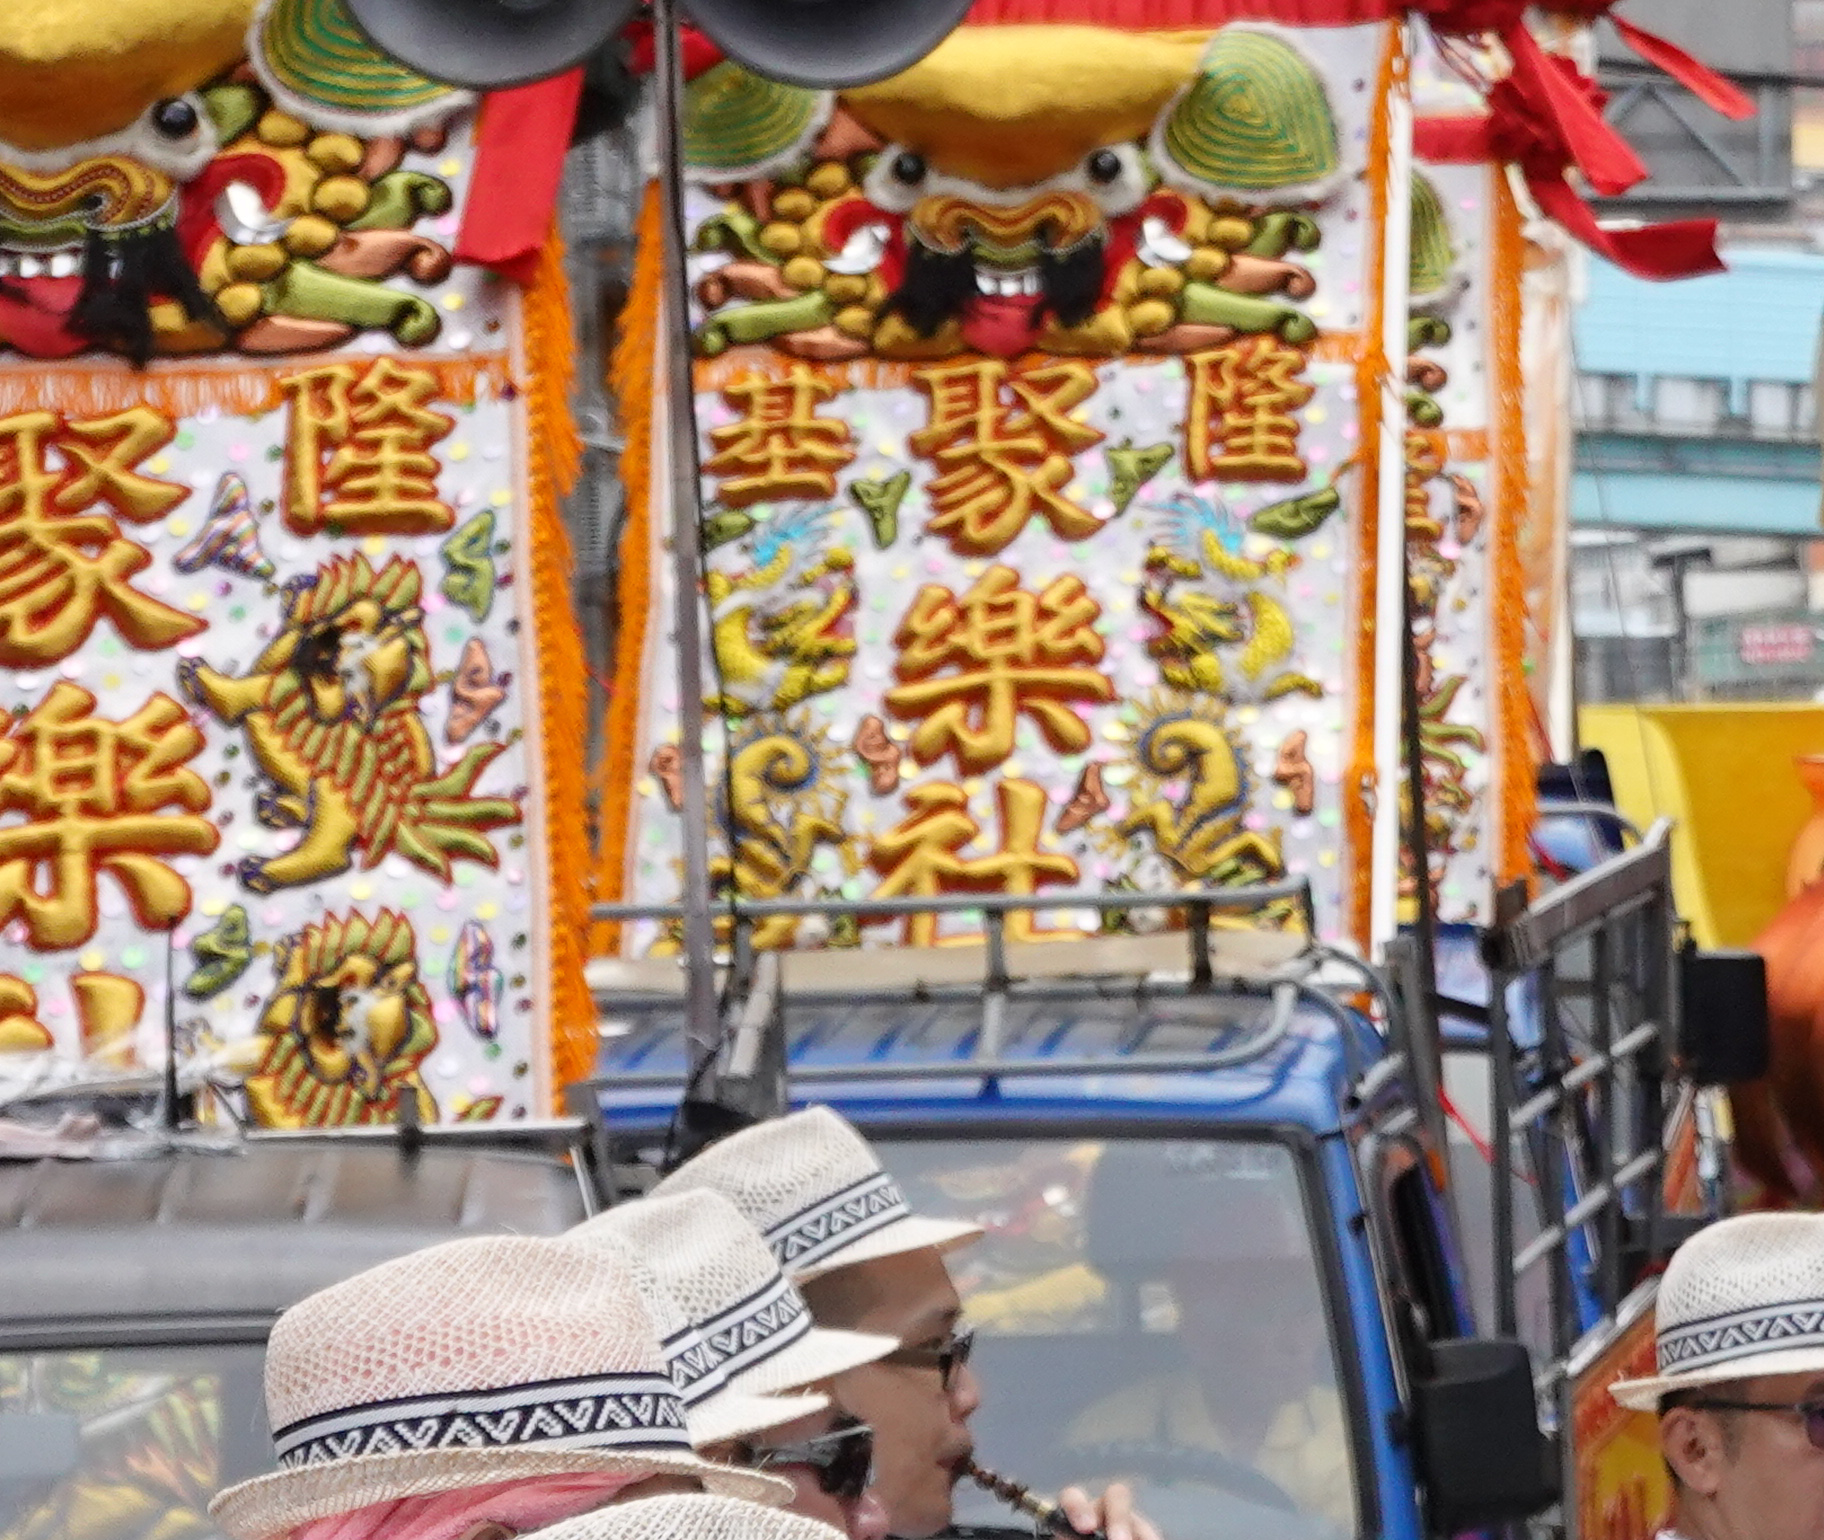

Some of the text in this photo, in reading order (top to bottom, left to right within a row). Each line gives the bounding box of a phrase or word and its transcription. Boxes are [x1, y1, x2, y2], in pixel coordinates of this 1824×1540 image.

[283, 356, 458, 537] 隆
[702, 362, 855, 505] 基
[1183, 340, 1312, 483] 隆
[0, 404, 220, 1068] 聚樂
